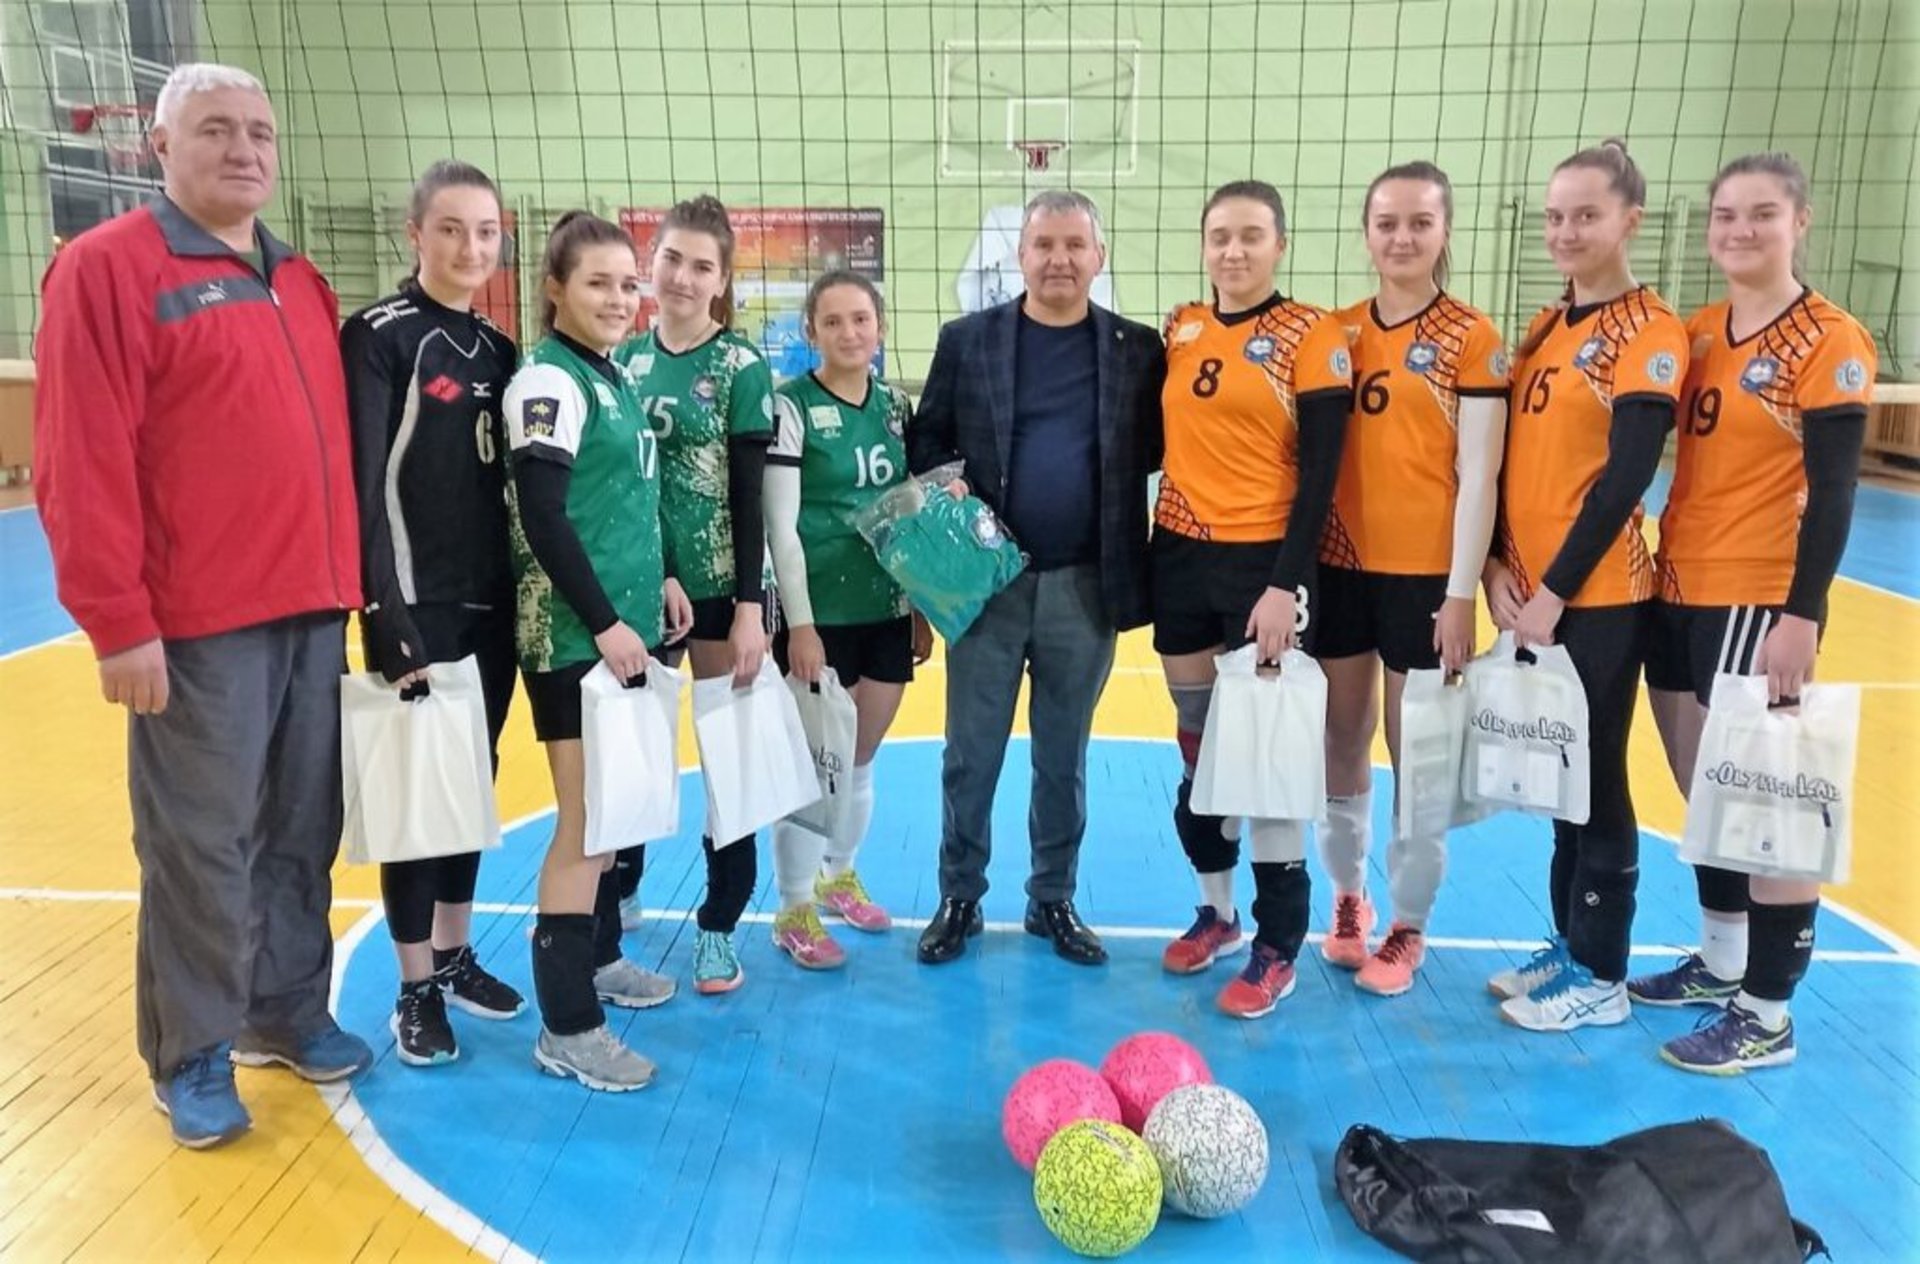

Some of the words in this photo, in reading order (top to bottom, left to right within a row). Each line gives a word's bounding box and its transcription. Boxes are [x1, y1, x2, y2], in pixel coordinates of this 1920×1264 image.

[1192, 358, 1223, 398] 8
[1521, 367, 1561, 414] 15
[1685, 386, 1722, 436] 19
[475, 409, 496, 464] 6
[636, 428, 657, 480] 17
[854, 443, 894, 488] 16
